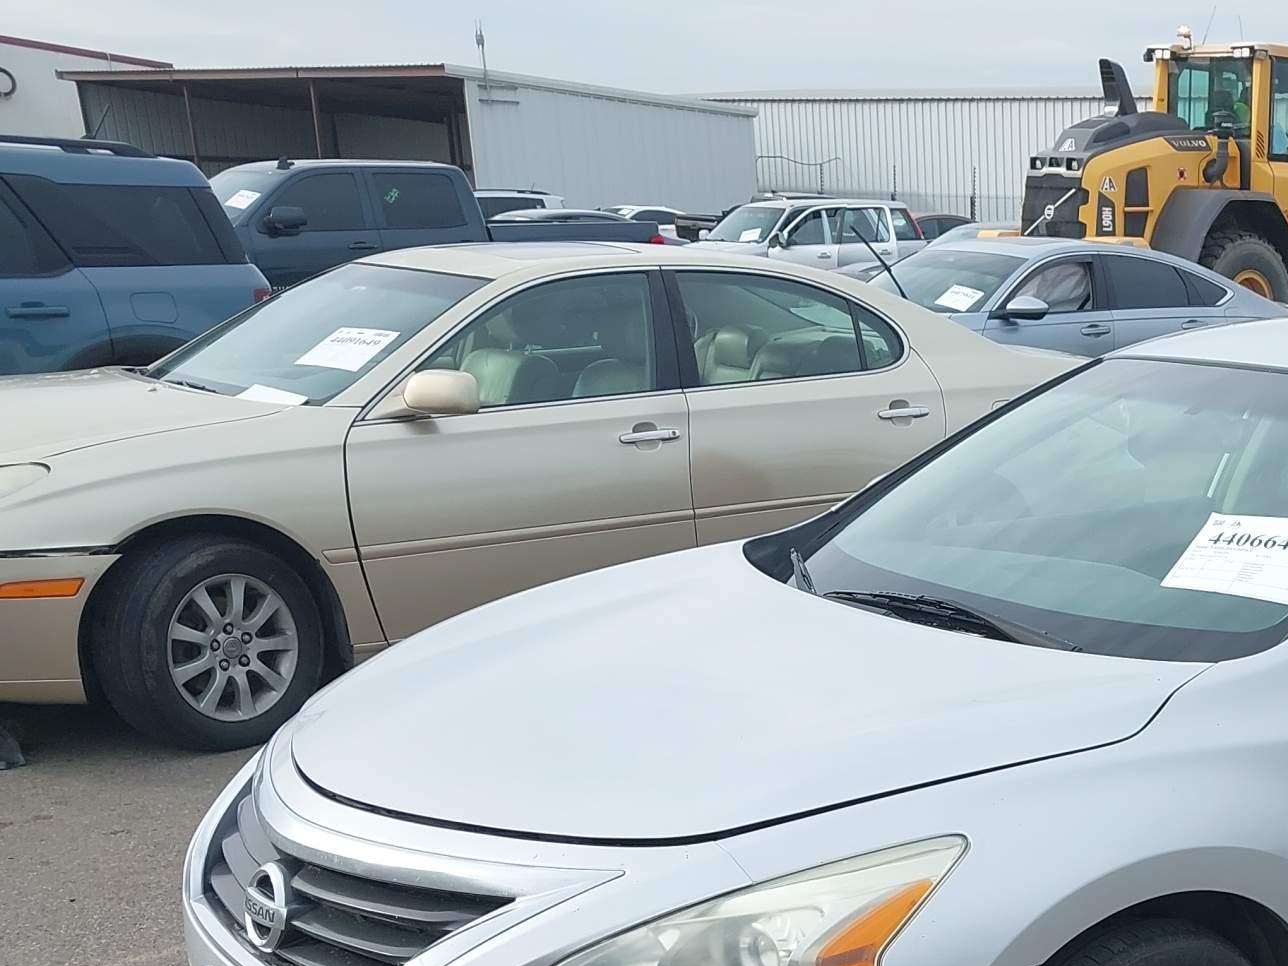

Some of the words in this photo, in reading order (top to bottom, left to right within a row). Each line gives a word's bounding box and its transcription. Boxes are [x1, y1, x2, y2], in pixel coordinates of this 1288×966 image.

[1170, 139, 1207, 147] VOLVO
[1102, 207, 1113, 231] L90H
[245, 897, 275, 922] SSAN
